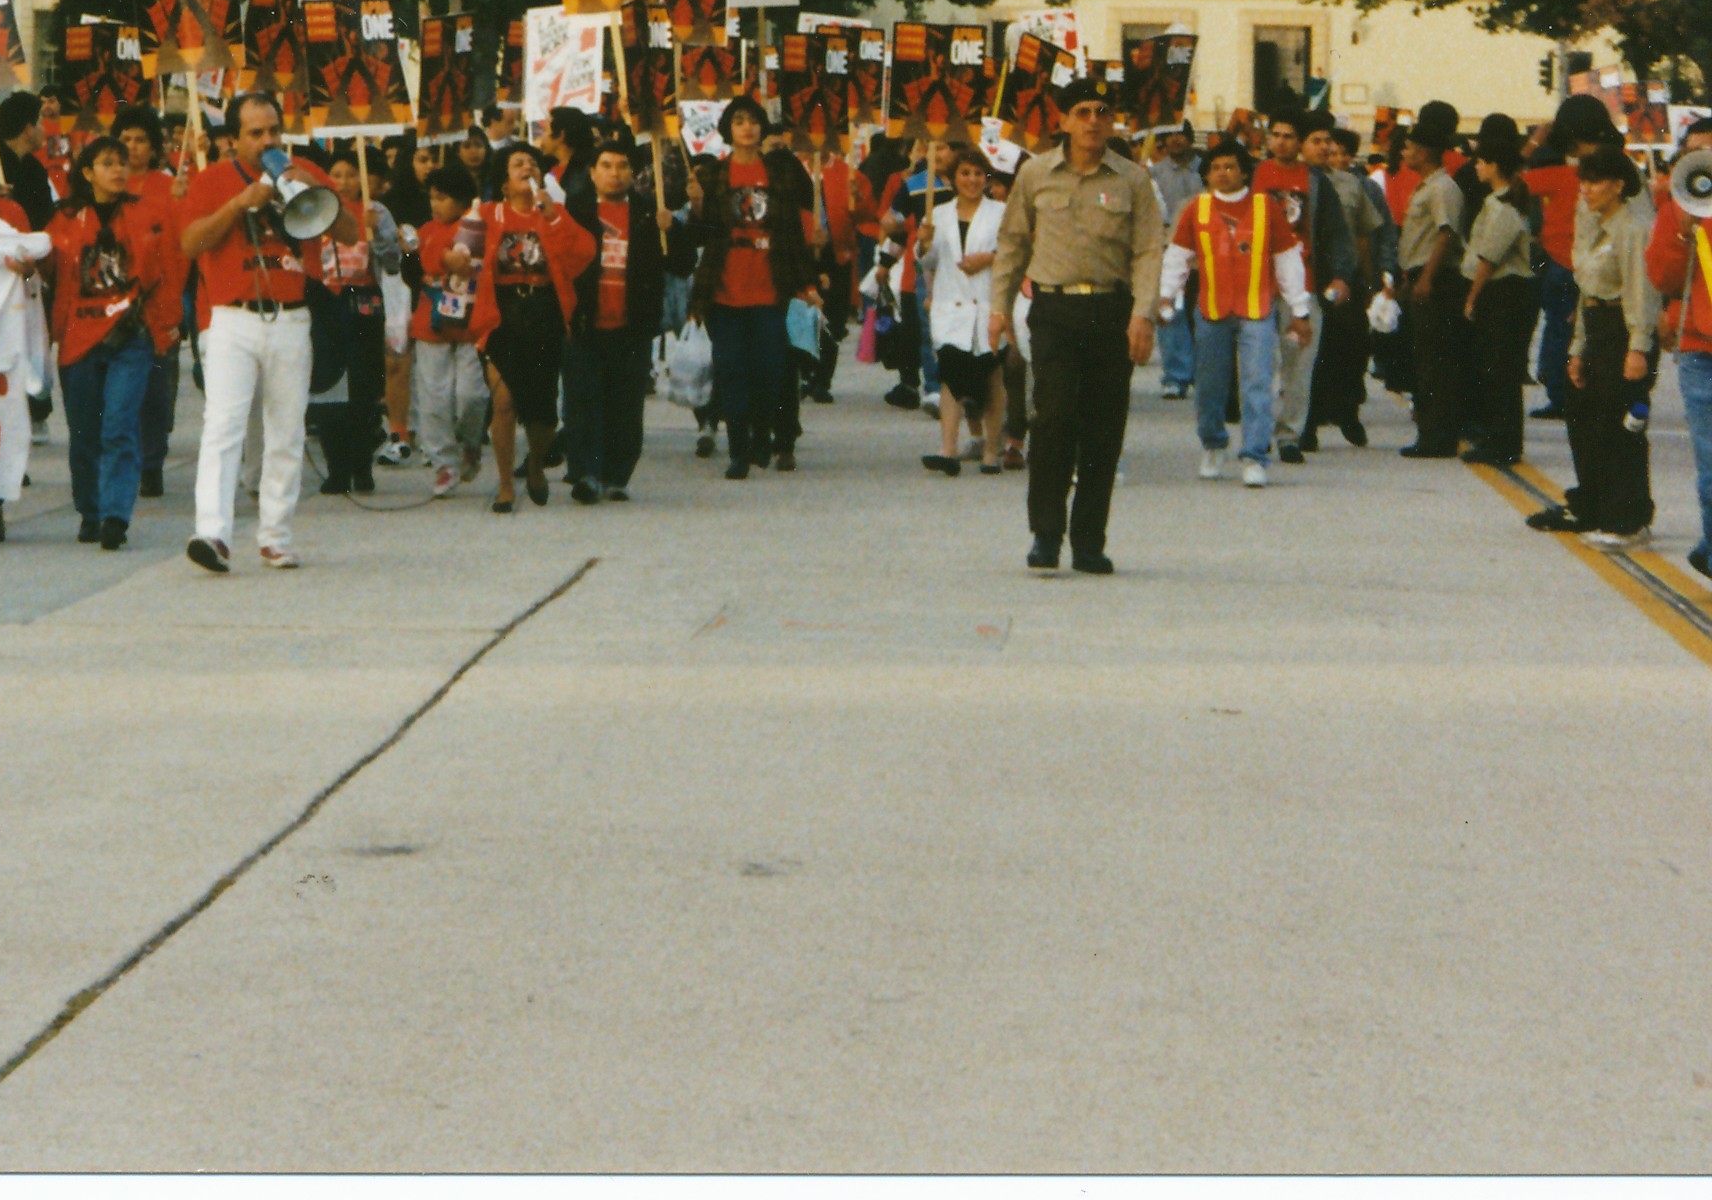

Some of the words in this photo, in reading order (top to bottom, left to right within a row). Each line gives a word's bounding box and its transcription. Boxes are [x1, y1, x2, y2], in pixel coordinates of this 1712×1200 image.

[360, 13, 395, 41] ONE
[116, 37, 141, 61] ON
[950, 39, 985, 66] ONE
